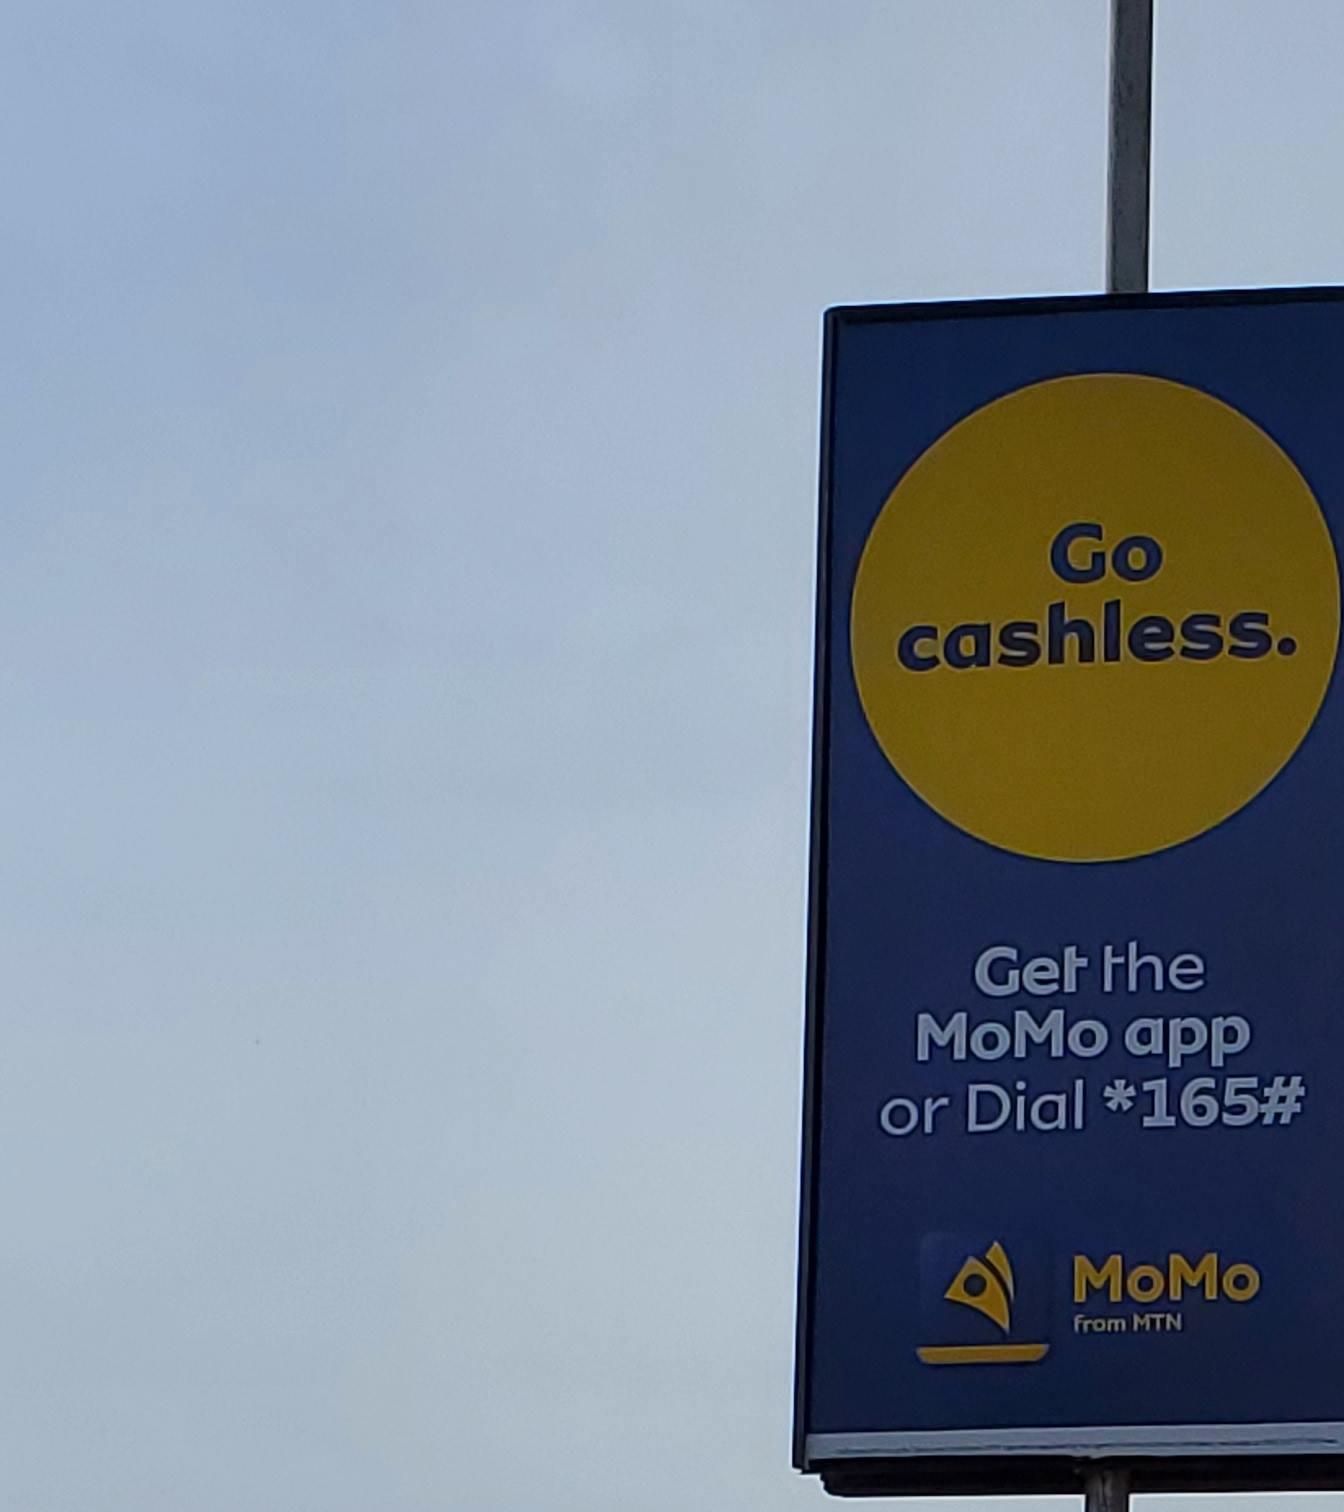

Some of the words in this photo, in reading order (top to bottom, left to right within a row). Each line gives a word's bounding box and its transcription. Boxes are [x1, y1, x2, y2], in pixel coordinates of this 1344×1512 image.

[1050, 522, 1163, 583] Go
[897, 599, 1297, 671] cashless.
[975, 945, 1088, 996] Get
[1103, 941, 1205, 993] the
[916, 1010, 1109, 1061] MoMo
[1124, 1014, 1251, 1068] app
[880, 1094, 949, 1136] or
[967, 1080, 1084, 1132] Dial
[1073, 1252, 1261, 1303] MoMo
[1074, 1314, 1126, 1333] from
[1133, 1313, 1182, 1332] MTN
